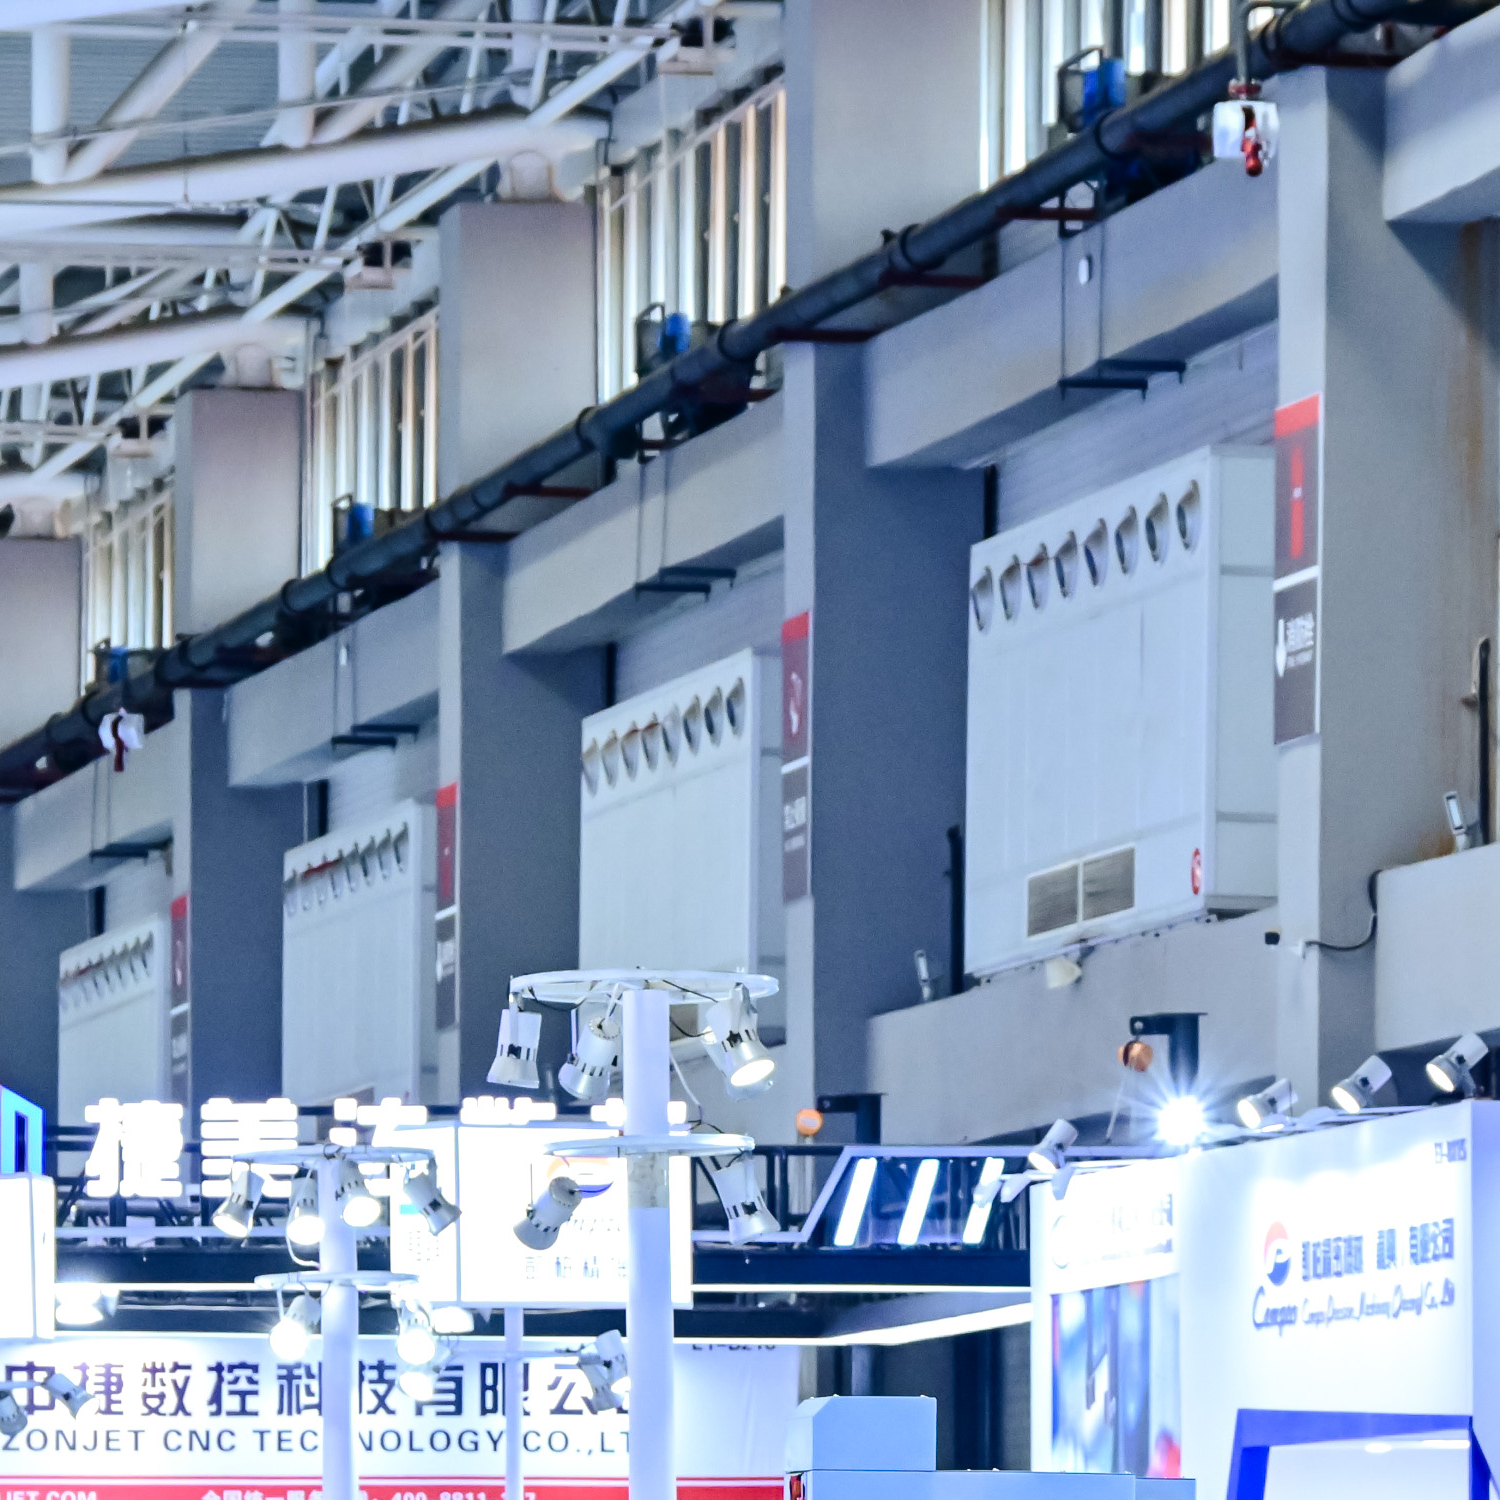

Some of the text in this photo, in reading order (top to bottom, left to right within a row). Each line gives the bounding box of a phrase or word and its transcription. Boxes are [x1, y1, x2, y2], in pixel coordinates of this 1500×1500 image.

[2, 1428, 145, 1452] ZONJET
[163, 1429, 238, 1453] CNC
[252, 1429, 505, 1454] TECNOLOGY
